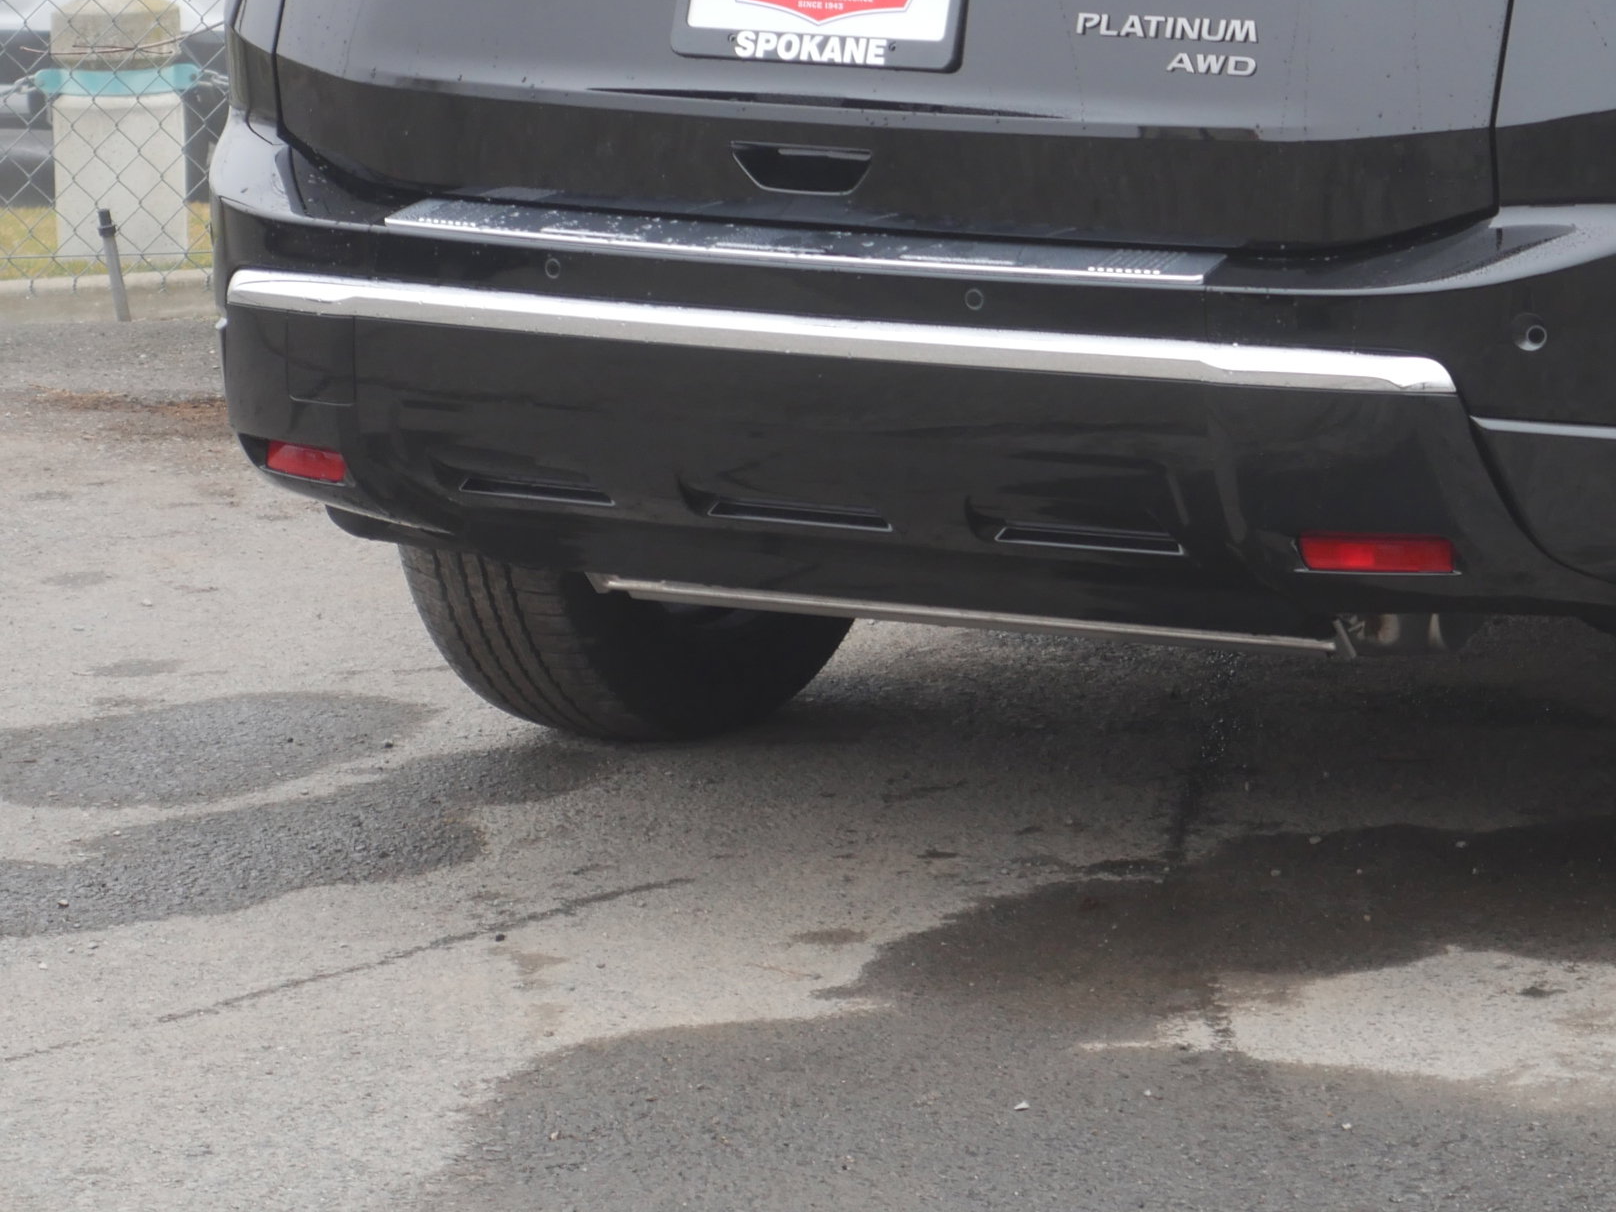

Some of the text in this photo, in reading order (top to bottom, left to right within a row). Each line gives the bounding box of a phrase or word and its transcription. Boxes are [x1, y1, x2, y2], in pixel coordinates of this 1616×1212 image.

[797, 0, 823, 9] SINCE
[1075, 12, 1258, 43] PLATINUM
[735, 30, 888, 66] SPOKANE
[1166, 52, 1257, 77] AWD
